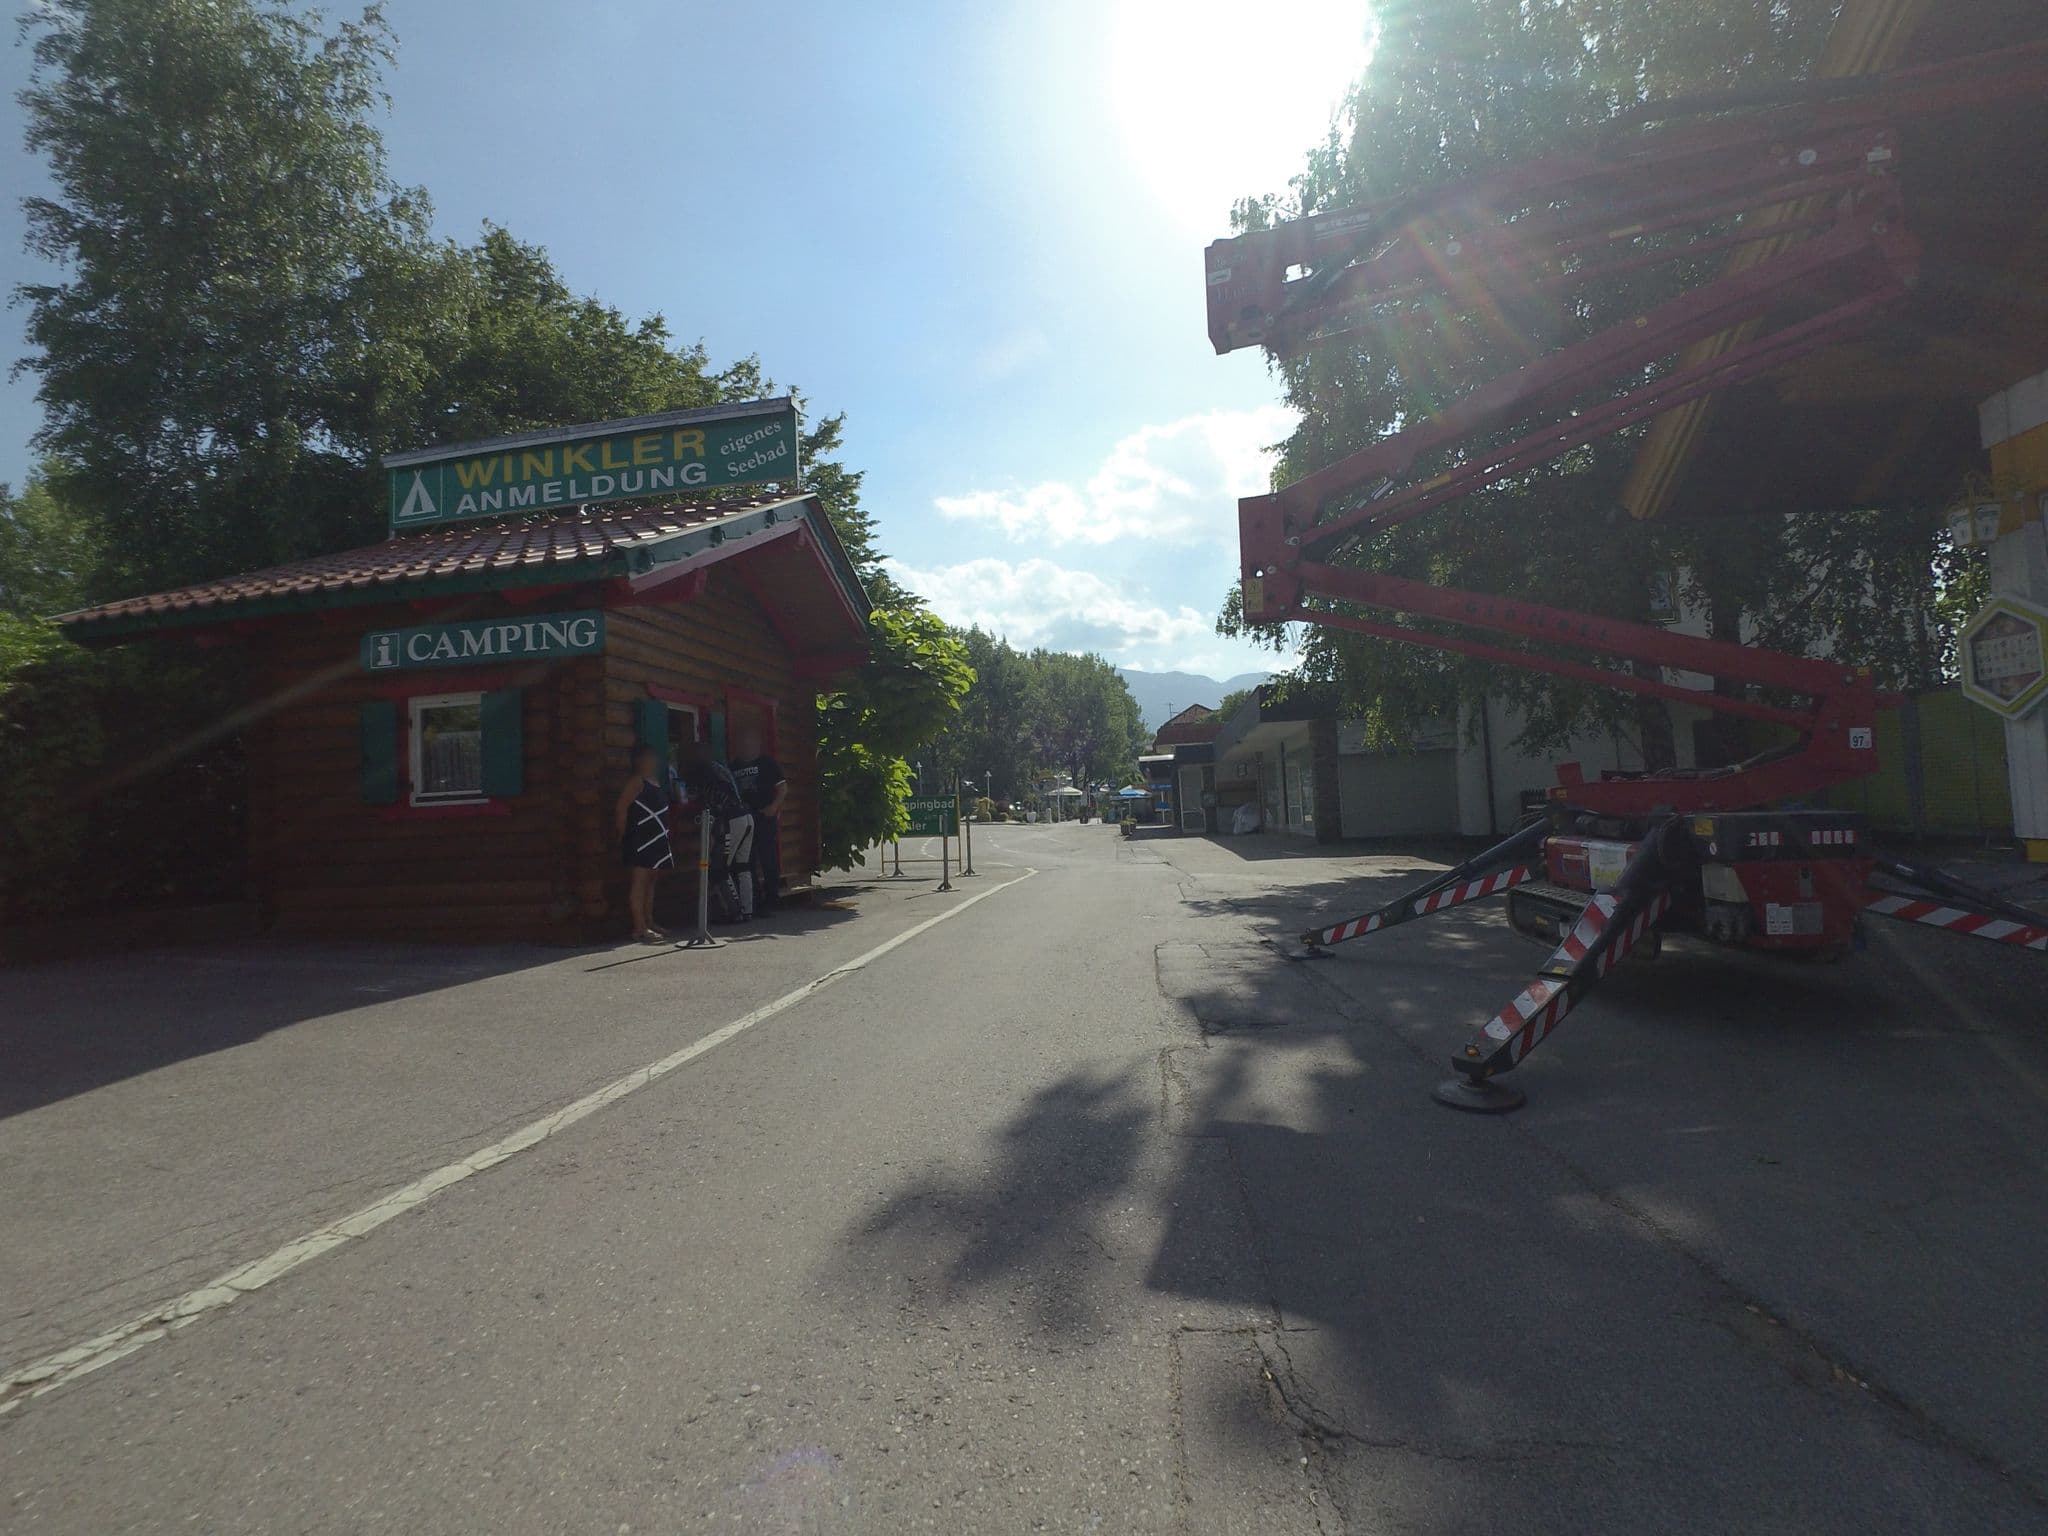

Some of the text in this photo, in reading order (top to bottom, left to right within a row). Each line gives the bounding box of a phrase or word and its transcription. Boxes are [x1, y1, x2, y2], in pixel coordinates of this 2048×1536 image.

[455, 429, 705, 489] WINKLER
[720, 421, 782, 456] eigenes
[727, 440, 789, 478] Seebad
[456, 462, 707, 514] ANMELDUNG
[407, 618, 598, 662] CAMPING
